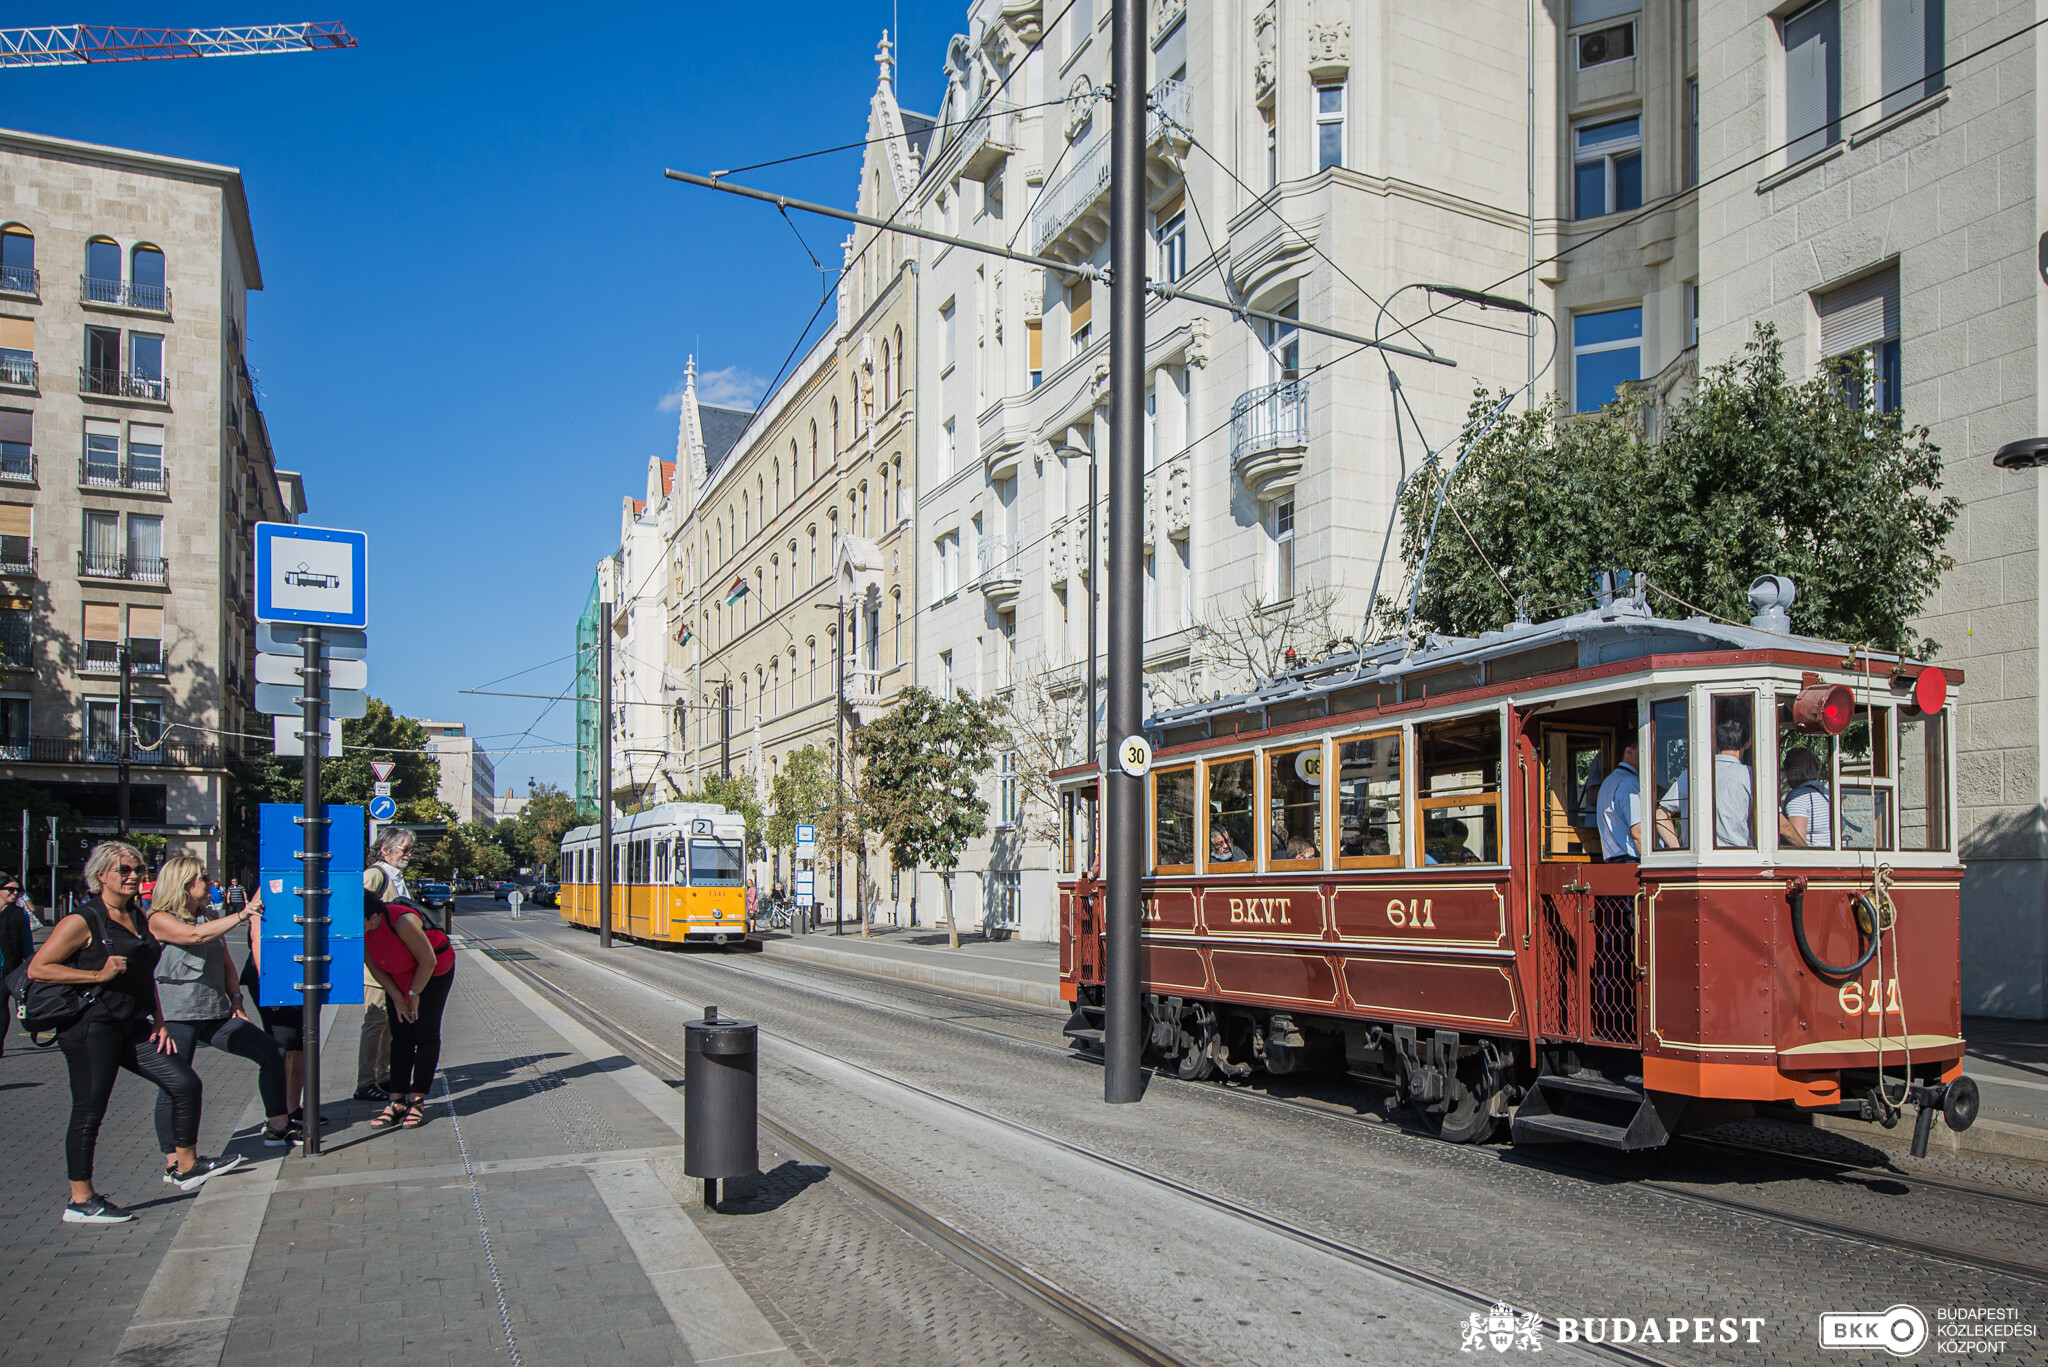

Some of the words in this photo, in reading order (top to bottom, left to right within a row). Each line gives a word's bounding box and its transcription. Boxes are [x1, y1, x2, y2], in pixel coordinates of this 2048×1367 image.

[1128, 747, 1144, 764] 30
[697, 822, 705, 833] 2
[1141, 899, 1162, 921] 11
[1229, 898, 1292, 925] B.K.V.T.
[1387, 899, 1436, 929] 611
[1839, 979, 1901, 1016] 611
